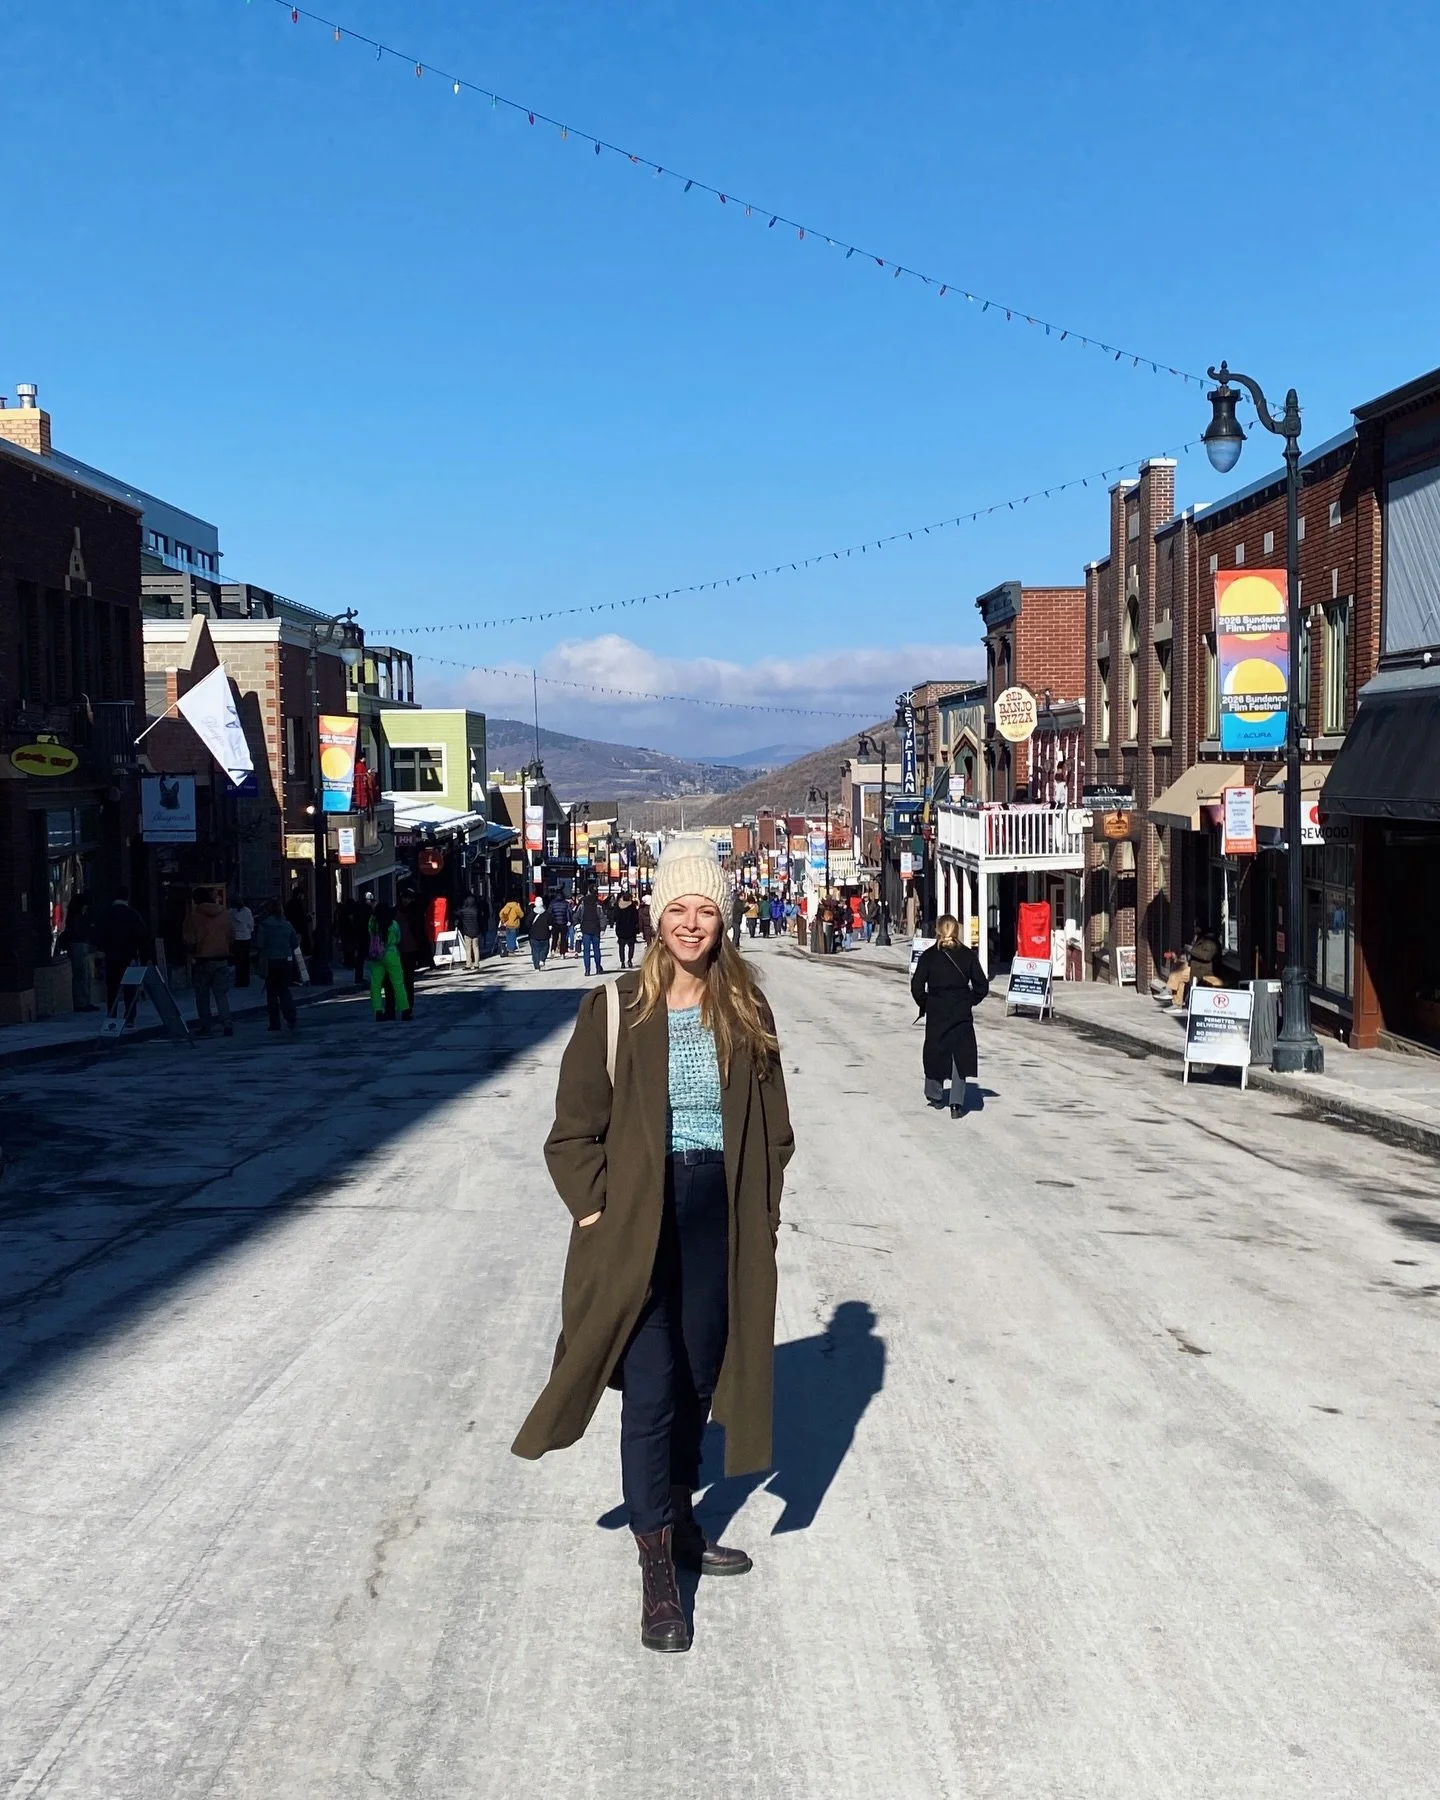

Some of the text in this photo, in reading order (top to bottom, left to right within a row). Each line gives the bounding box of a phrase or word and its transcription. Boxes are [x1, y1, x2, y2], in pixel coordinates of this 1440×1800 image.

[1242, 615, 1287, 624] Sundance
[1225, 622, 1280, 632] Film Festival
[1006, 691, 1023, 701] RED
[1221, 695, 1288, 704] 2026 Sundance
[999, 701, 1032, 714] BANJO
[1229, 702, 1281, 712] Film Festival
[1000, 712, 1033, 725] PIZZA
[904, 706, 915, 793] EGYPTIAN
